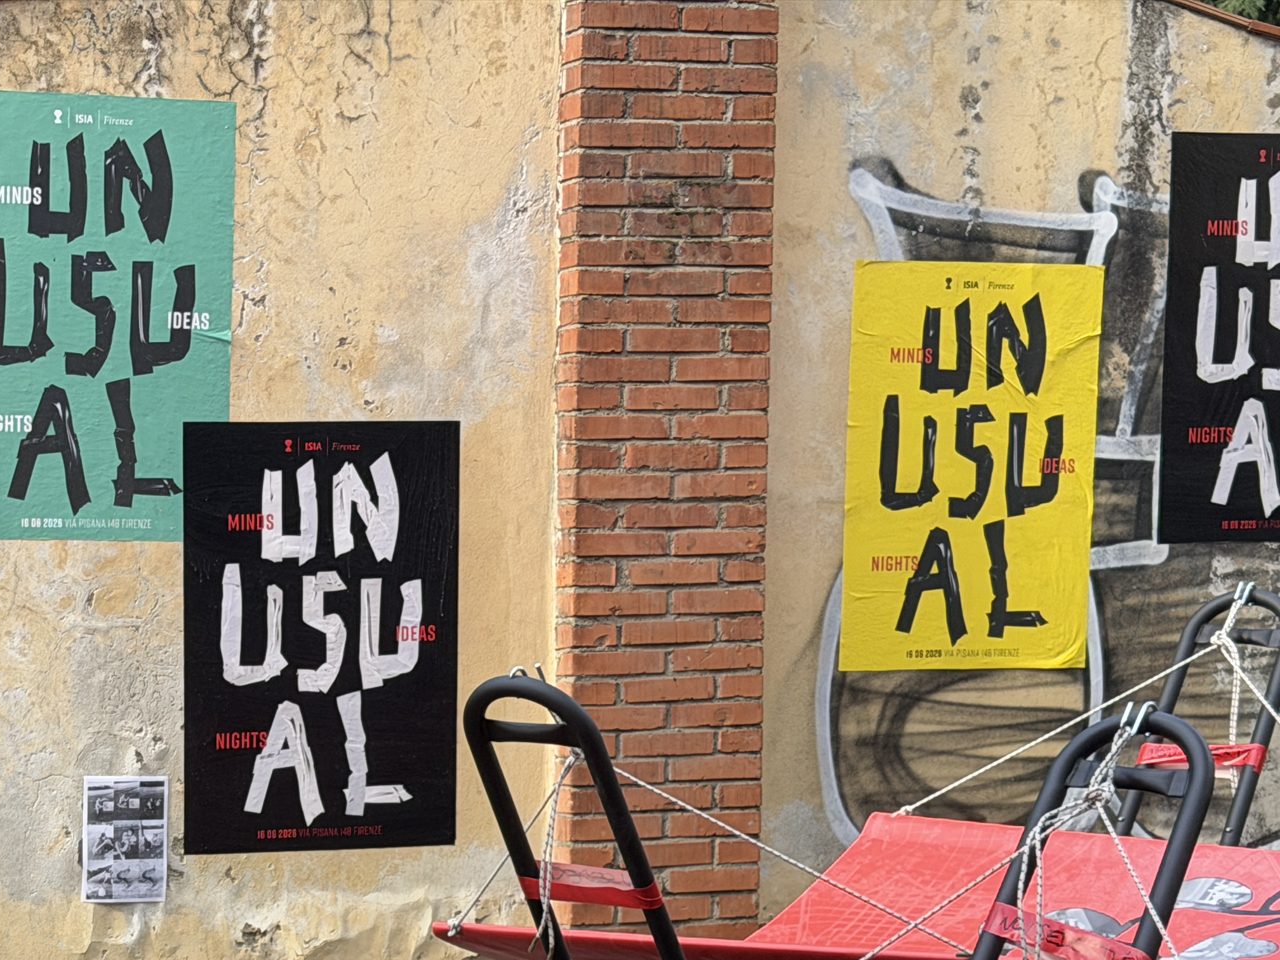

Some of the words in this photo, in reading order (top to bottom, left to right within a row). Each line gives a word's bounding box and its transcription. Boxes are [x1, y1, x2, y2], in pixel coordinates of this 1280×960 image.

[75, 114, 93, 124] ISIA
[103, 115, 134, 126] Firenze
[1207, 219, 1248, 237] MINDS
[963, 280, 979, 289] ISIA
[167, 311, 210, 330] IDEAS
[890, 347, 933, 364] MINDS
[1188, 426, 1234, 444] NIGHTS
[7, 378, 183, 516] AL
[304, 442, 322, 451] ISIA
[1038, 458, 1075, 474] IDEAS
[65, 518, 77, 528] VIA
[121, 518, 152, 529] FIRENZE
[227, 513, 274, 531] MINDS
[871, 555, 920, 572] NIGHTS
[894, 518, 1049, 647] AL
[395, 624, 436, 642] IDEAS
[216, 731, 268, 750] NIGHTS
[243, 690, 413, 826] AL
[353, 825, 382, 836] FIRENZE
